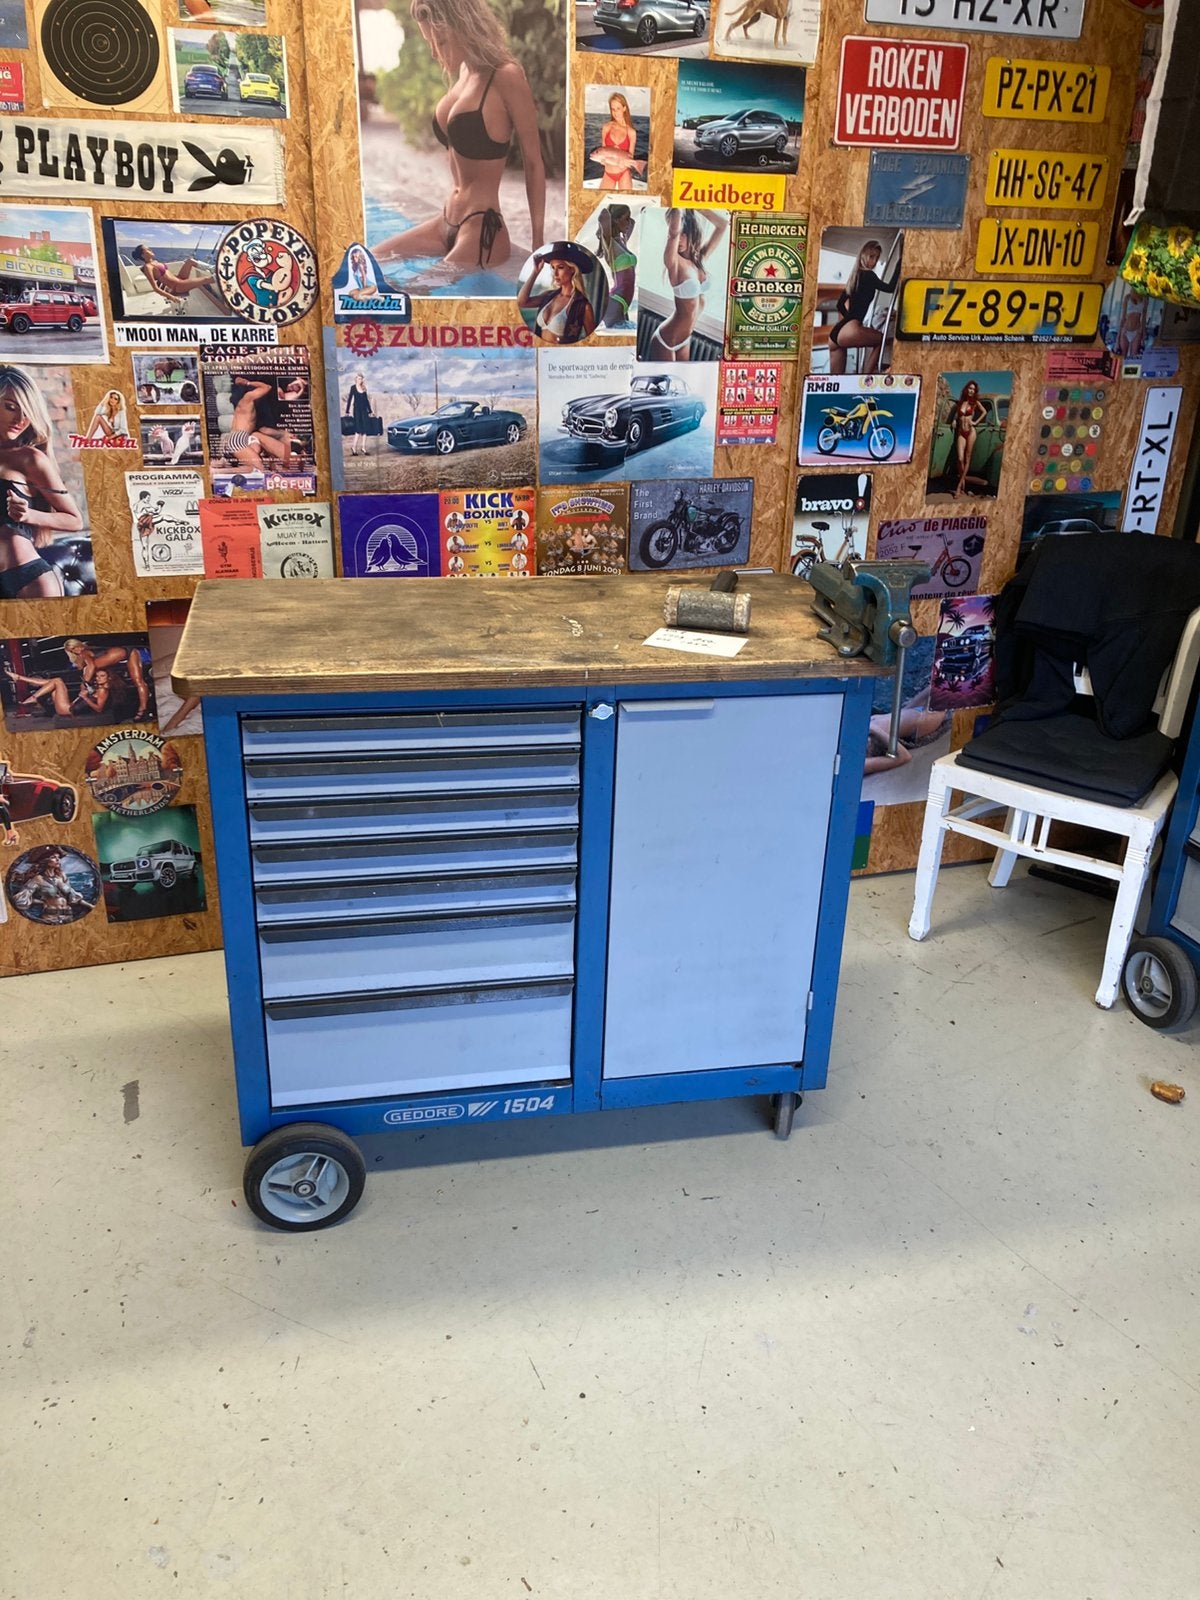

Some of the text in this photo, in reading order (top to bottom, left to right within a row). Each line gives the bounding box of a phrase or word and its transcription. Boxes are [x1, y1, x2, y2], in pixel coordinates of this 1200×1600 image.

[868, 46, 943, 91] ROKEN
[996, 66, 1098, 114] PZ-PX-21
[845, 93, 957, 139] VERBODEN
[15, 125, 178, 194] PLAYBOY
[995, 158, 1103, 201] HH-SG-47
[679, 181, 775, 210] Zuidberg
[226, 223, 310, 263] POPEYE
[991, 228, 1086, 267] JX-DN-10
[6, 260, 63, 276] BICYCLES
[230, 292, 304, 323] SALOR
[921, 287, 1084, 328] FZ-89-BJ
[211, 328, 227, 341] DE
[232, 328, 275, 342] KARRE
[389, 326, 533, 347] ZUIDBERG
[204, 355, 305, 364] TOURNAMENT
[548, 363, 556, 371] De
[558, 364, 595, 373] sportwagen
[807, 382, 840, 392] RM80
[1130, 411, 1173, 534] -RT-XL
[290, 479, 312, 489] FUN
[634, 489, 649, 497] The
[465, 492, 514, 508] KICK
[263, 512, 326, 529] KICKBOX
[464, 510, 513, 519] BOXING
[634, 511, 658, 519] Brand
[156, 526, 201, 535] KICKBOX
[877, 516, 987, 540] Ciao de PIAGGIO
[583, 564, 602, 572] JUNI
[603, 565, 622, 576] 2003
[96, 729, 164, 755] AMSTERDAM
[110, 799, 169, 816] NETHERLANDS
[390, 1095, 555, 1122] GEDORE 1504
